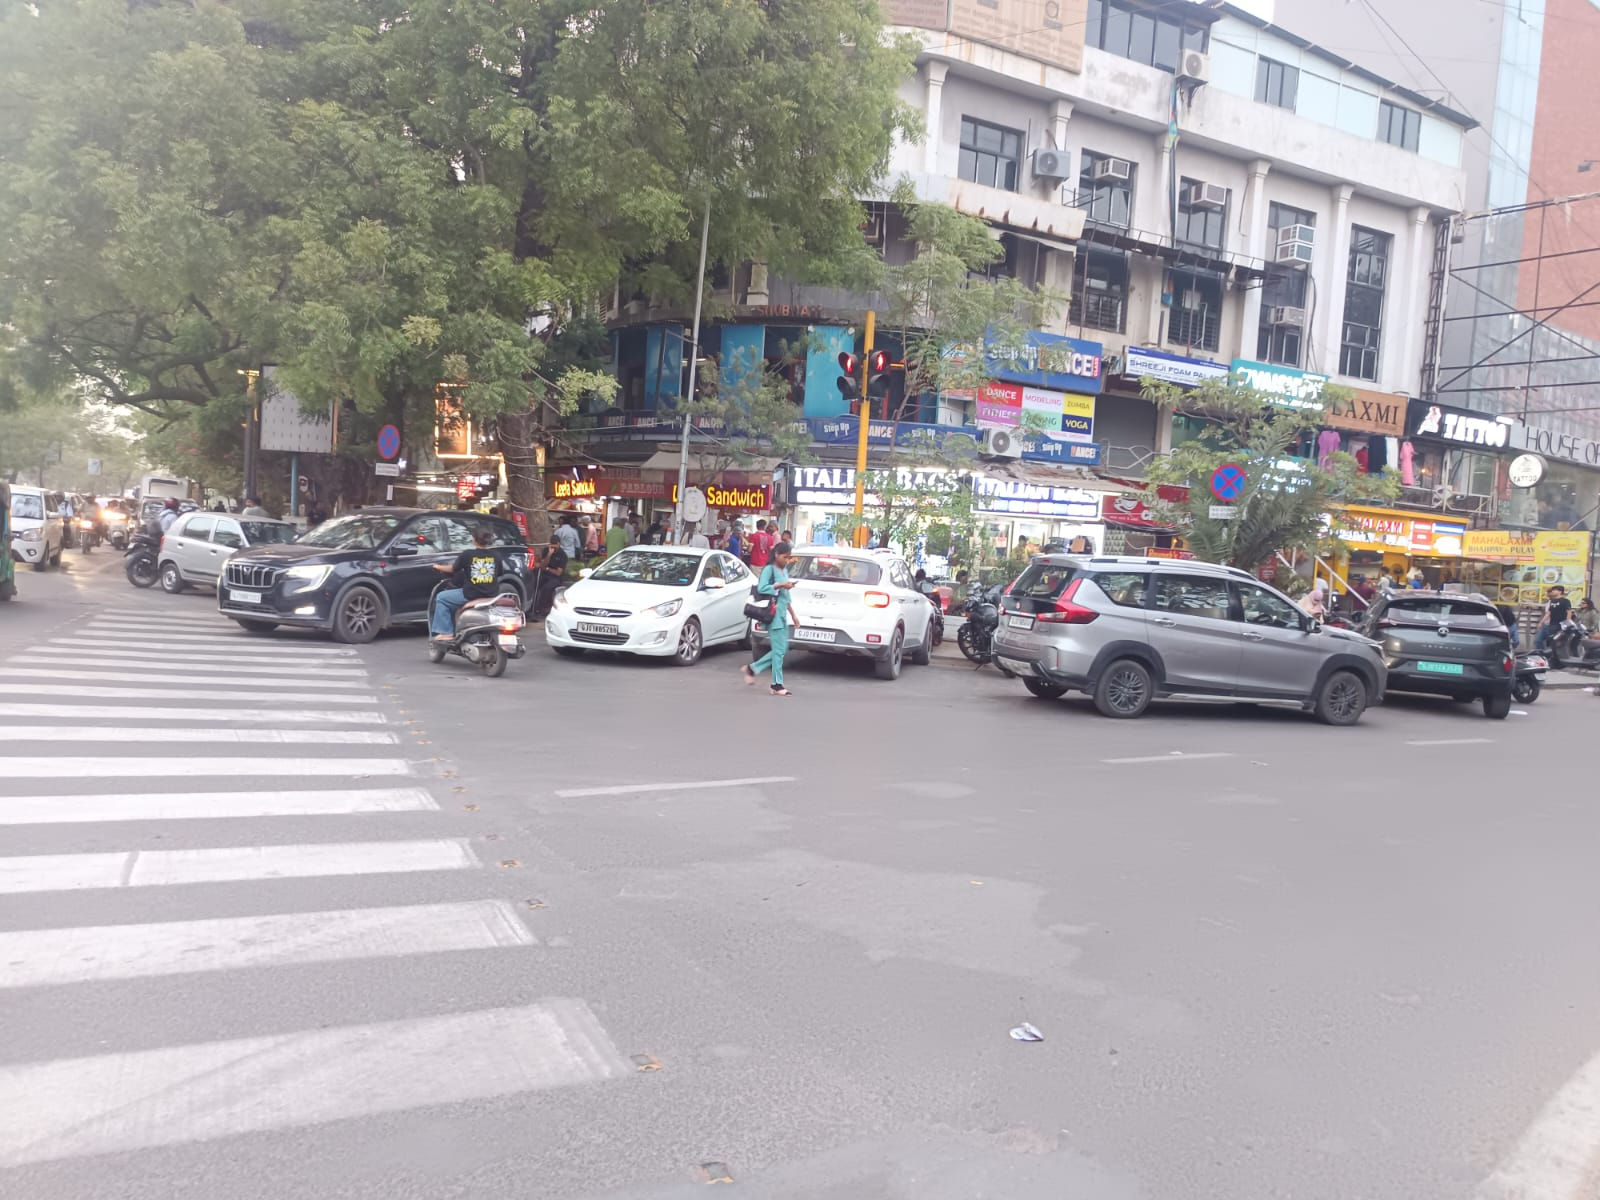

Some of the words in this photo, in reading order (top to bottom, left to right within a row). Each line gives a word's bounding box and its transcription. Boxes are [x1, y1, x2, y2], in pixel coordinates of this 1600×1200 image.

[1168, 367, 1191, 377] FOAM
[986, 388, 1017, 400] DANCE
[1025, 394, 1062, 406] MODELING
[1066, 420, 1089, 430] YOGA
[1443, 414, 1507, 447] TATTOO
[1526, 425, 1580, 461] HOUSE
[707, 486, 764, 507] Sandwich
[1472, 535, 1532, 546] MAHALAXMI
